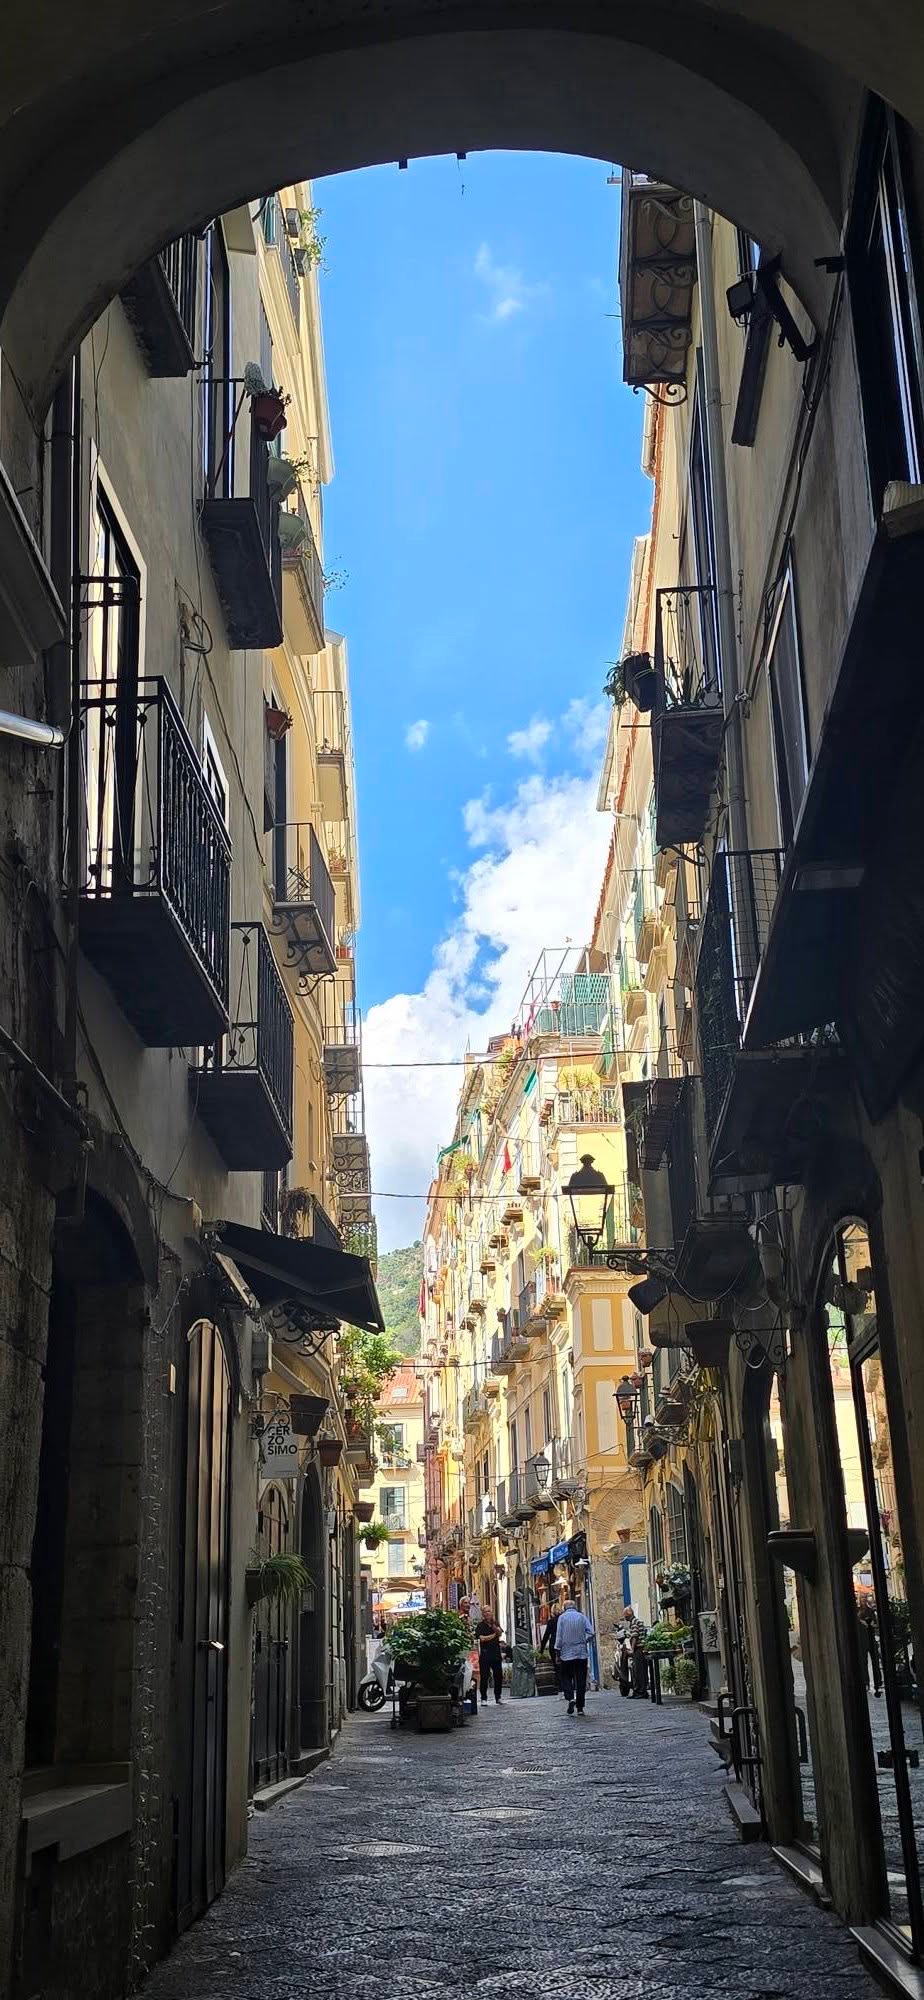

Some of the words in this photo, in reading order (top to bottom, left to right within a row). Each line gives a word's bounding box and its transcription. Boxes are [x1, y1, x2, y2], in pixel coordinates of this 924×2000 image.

[267, 1426, 290, 1436] CER
[268, 1436, 284, 1445] ZO
[268, 1445, 298, 1455] SIMO
